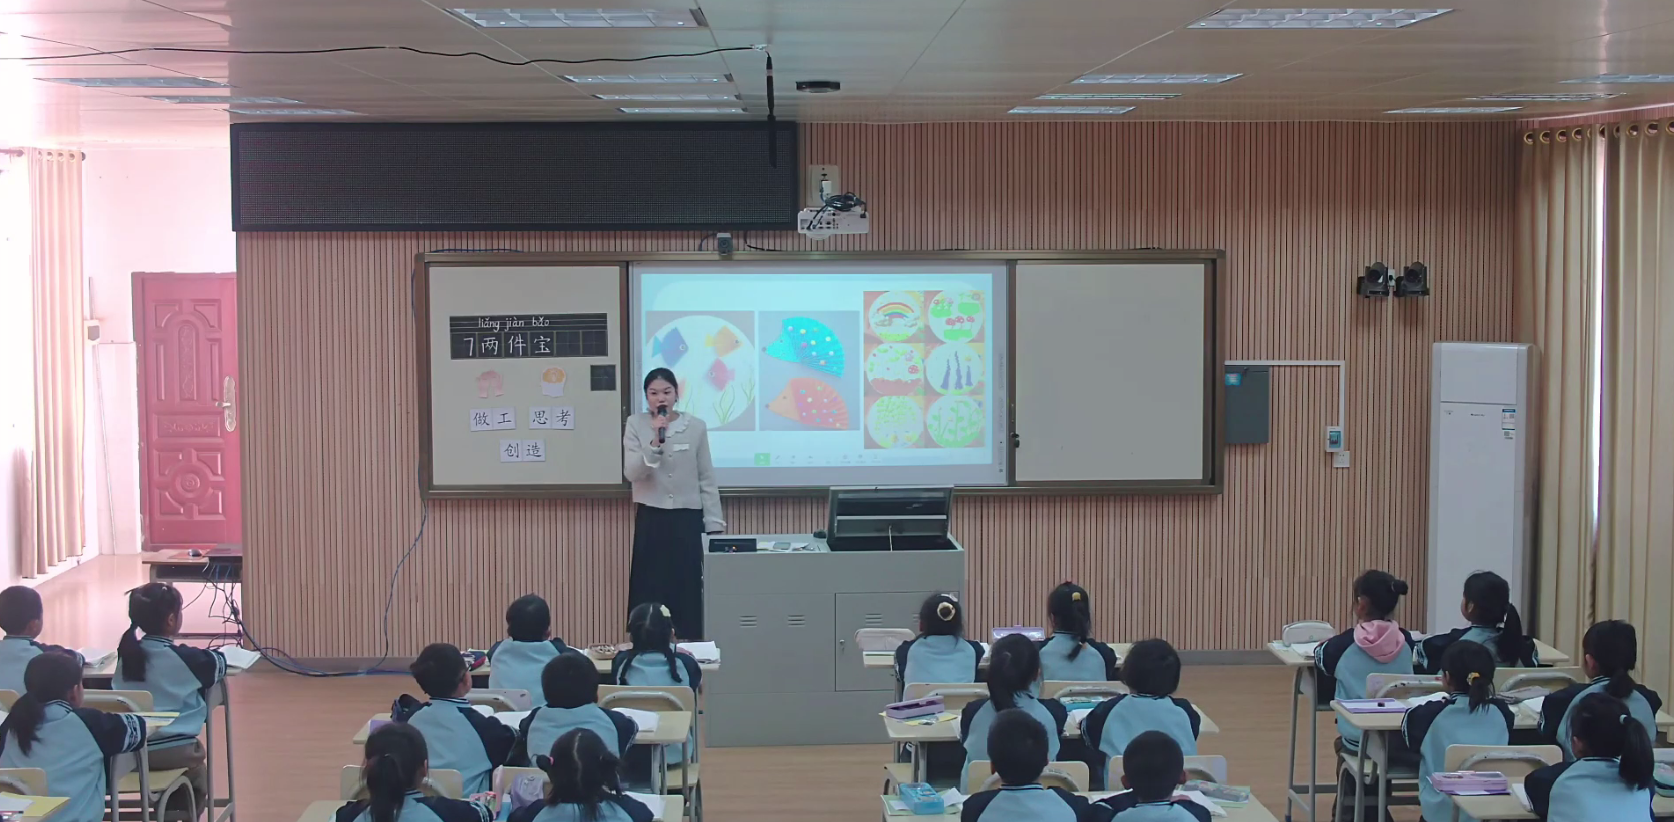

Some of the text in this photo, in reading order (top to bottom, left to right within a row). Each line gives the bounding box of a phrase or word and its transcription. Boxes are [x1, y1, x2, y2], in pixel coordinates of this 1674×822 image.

[478, 316, 550, 332] liǎng jiàn bǎo
[473, 411, 512, 427] 做工
[532, 409, 571, 427] 思考
[504, 442, 542, 458] 创造
